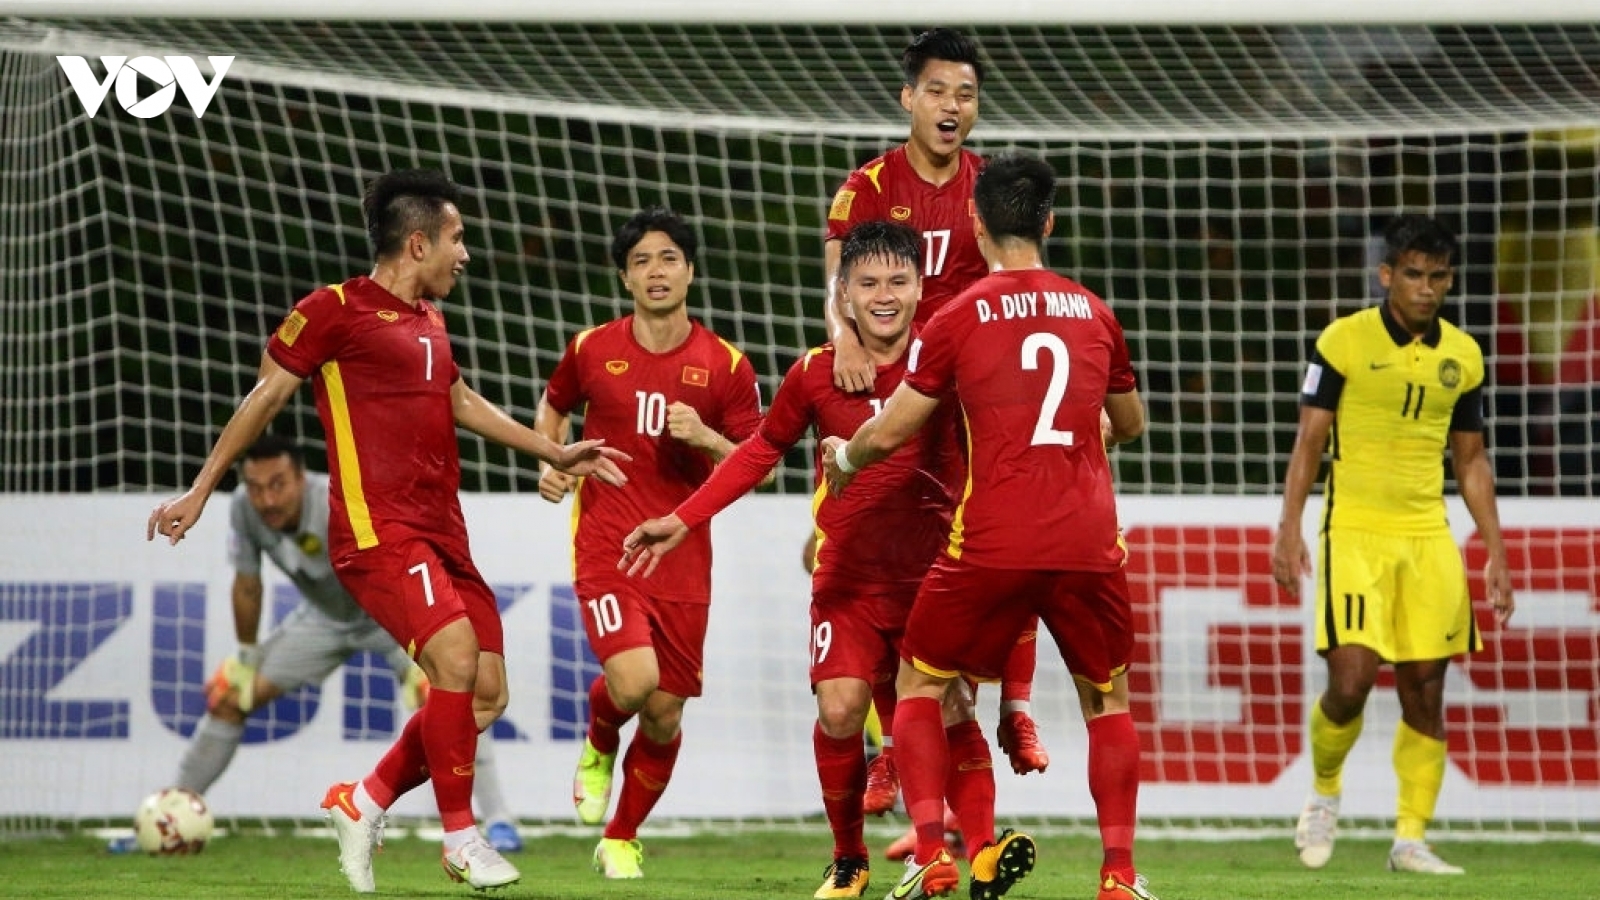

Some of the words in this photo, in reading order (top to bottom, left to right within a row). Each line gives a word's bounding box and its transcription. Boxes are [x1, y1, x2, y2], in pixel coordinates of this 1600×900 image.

[922, 229, 951, 276] 17
[976, 299, 998, 323] D.
[1000, 291, 1037, 320] DUY
[1042, 291, 1093, 320] MANH
[418, 336, 434, 381] 7
[1020, 332, 1074, 446] 2
[1401, 382, 1426, 420] 11
[635, 390, 667, 437] 10
[408, 562, 435, 607] 7
[588, 593, 623, 639] 10
[1344, 593, 1366, 631] 11
